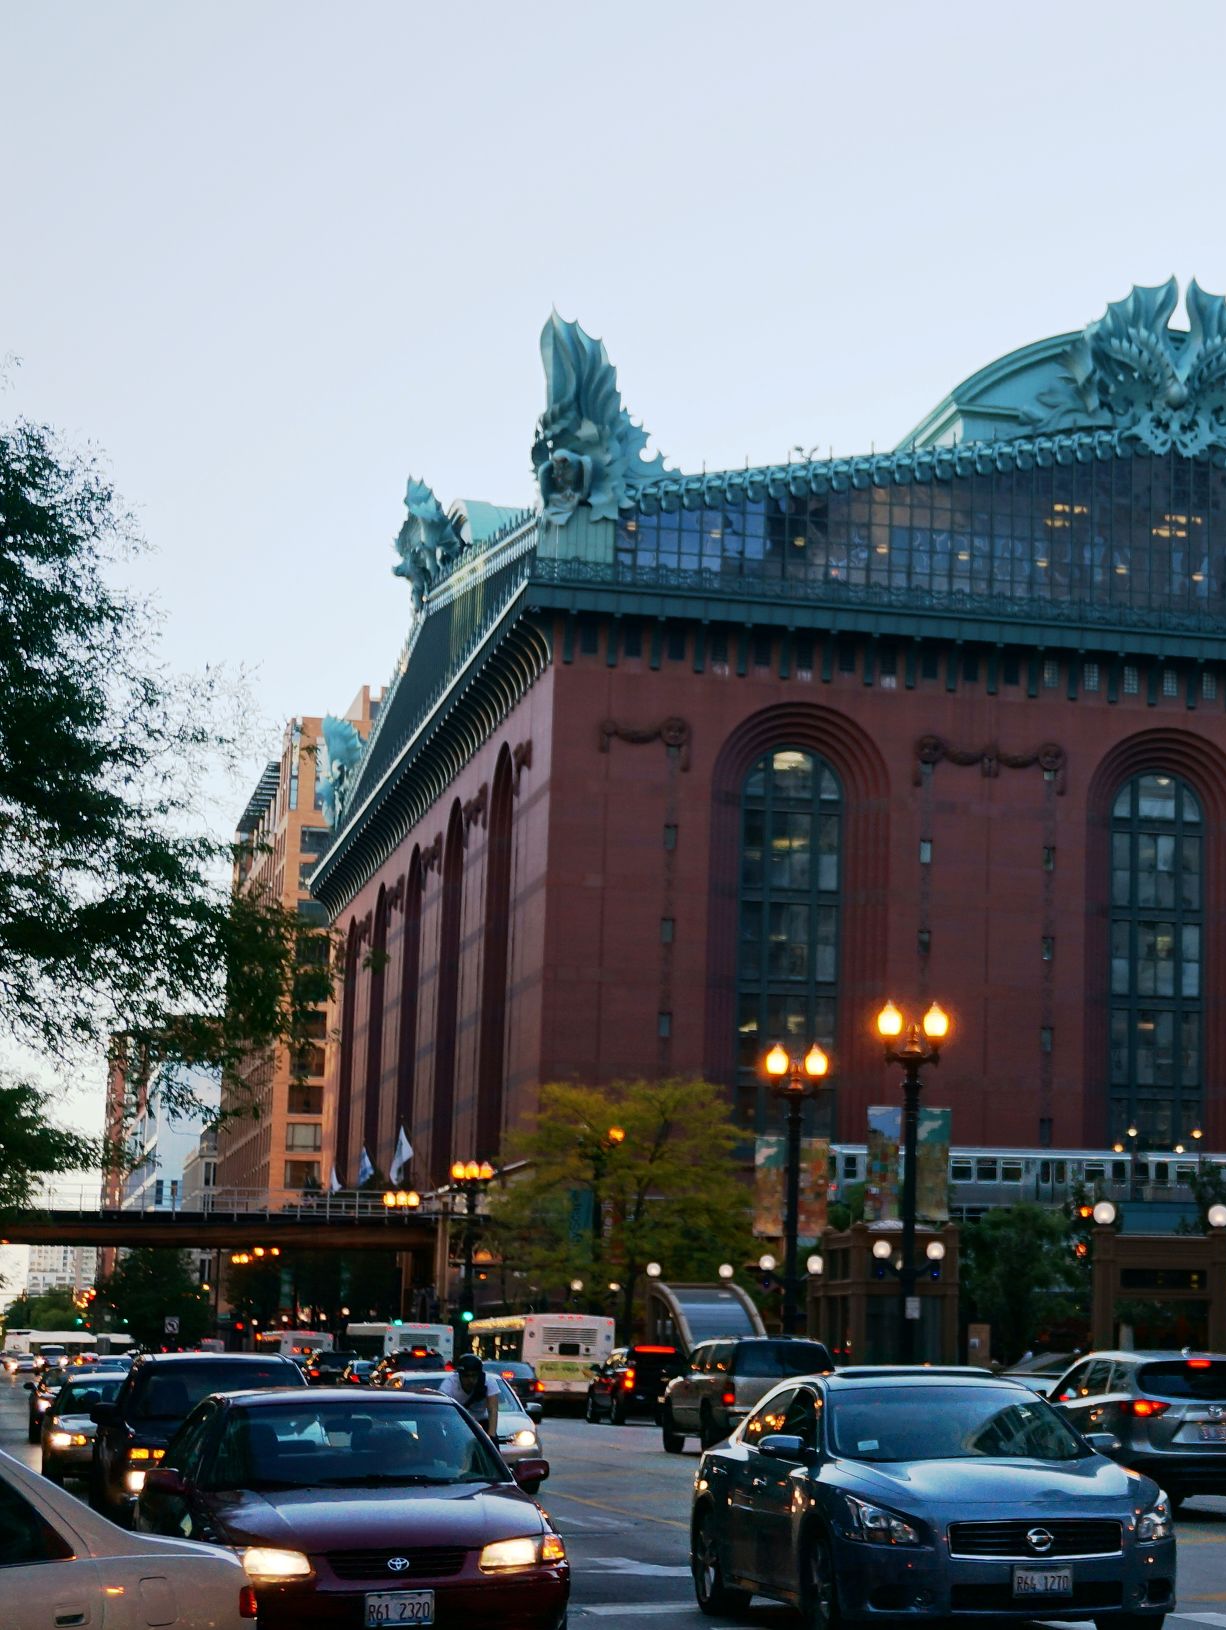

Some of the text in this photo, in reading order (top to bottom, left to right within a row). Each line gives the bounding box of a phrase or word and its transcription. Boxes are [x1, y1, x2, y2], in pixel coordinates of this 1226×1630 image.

[1016, 1576, 1037, 1593] R64
[368, 1601, 430, 1621] R61 2320
